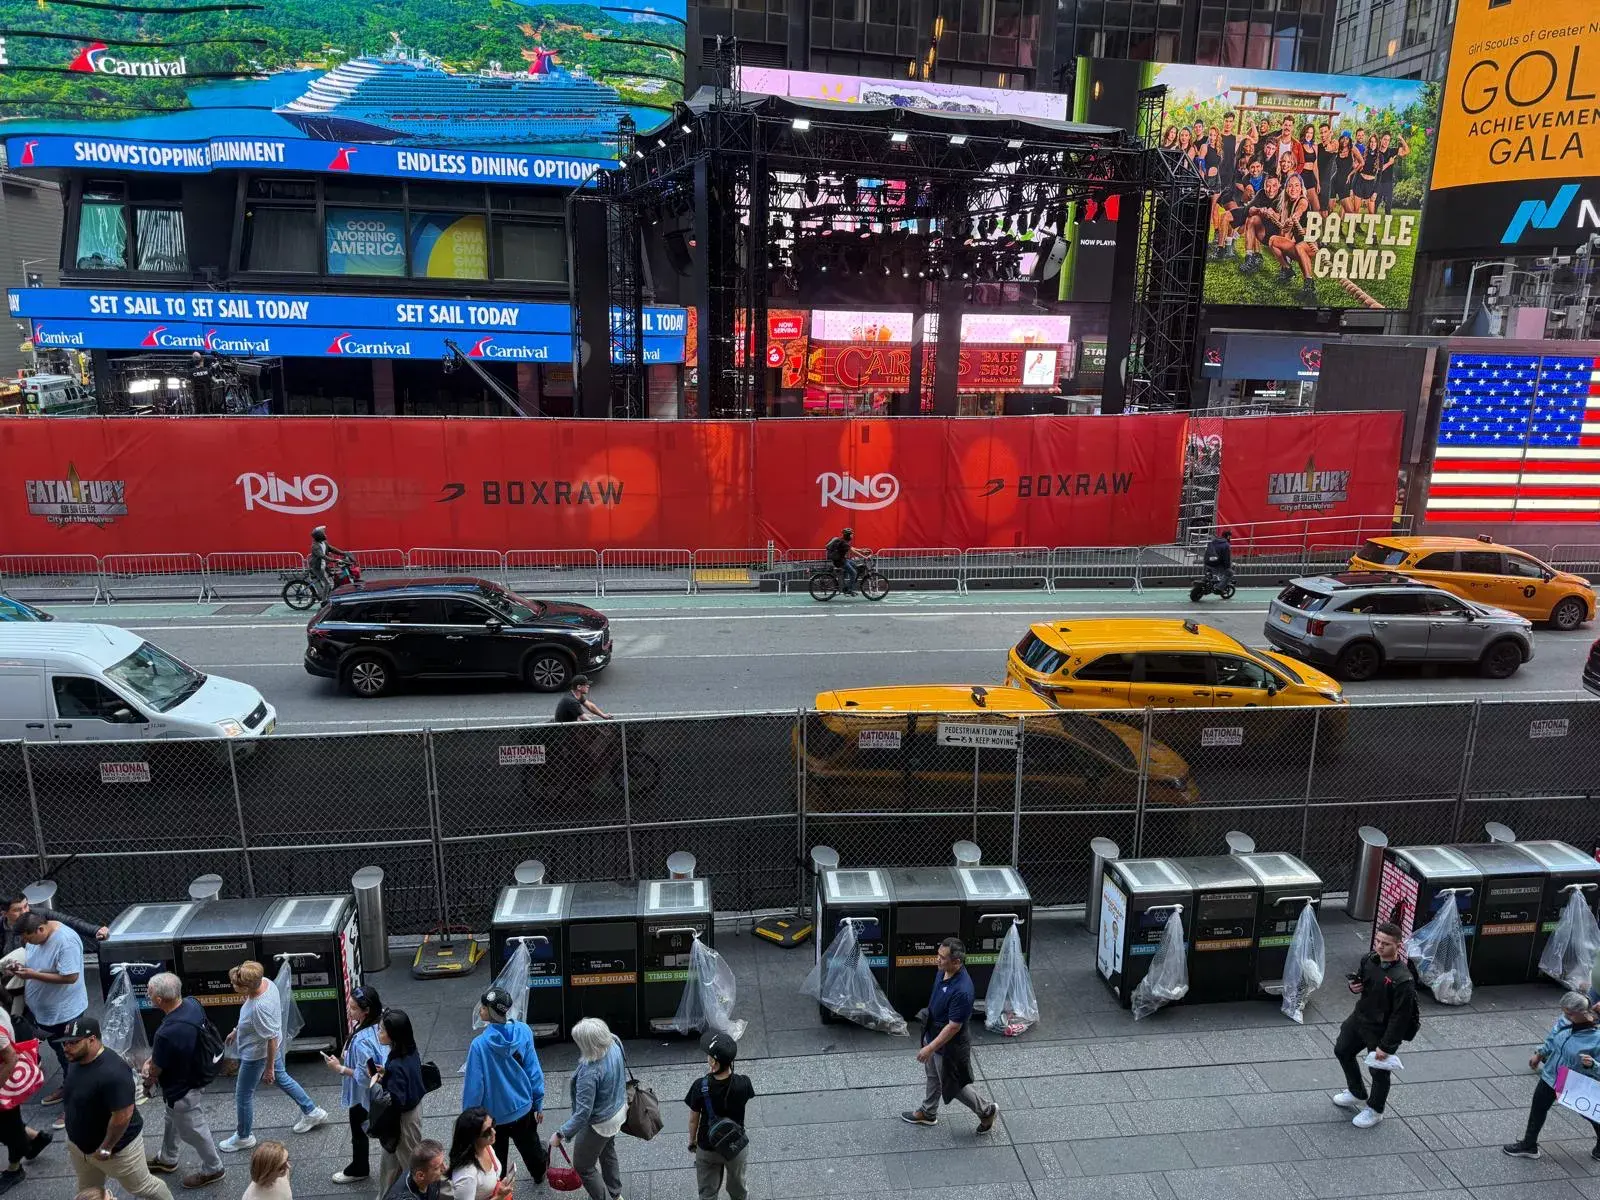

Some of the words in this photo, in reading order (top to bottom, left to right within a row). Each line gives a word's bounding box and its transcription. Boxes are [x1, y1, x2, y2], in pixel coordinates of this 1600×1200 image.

[1468, 43, 1483, 56] Girl
[1484, 36, 1519, 52] Scouts
[1523, 31, 1535, 42] of
[1538, 24, 1585, 40] Greater
[99, 56, 187, 77] Carnival
[1461, 45, 1596, 115] GOL
[1262, 96, 1292, 106] BATTLE
[1293, 98, 1316, 108] CAMP
[74, 141, 204, 167] SHOWSTOPPING
[1489, 132, 1584, 165] GALA
[398, 151, 466, 175] ENDLESS
[472, 153, 528, 177] DINING
[533, 158, 600, 181] OPTIONS
[346, 221, 386, 232] GOOD
[1303, 211, 1416, 246] BATTLE
[337, 230, 396, 243] MORNING
[453, 231, 484, 243] GMA
[329, 241, 405, 257] AMERICA
[453, 244, 485, 256] GMA
[453, 257, 485, 268] GMA
[1314, 249, 1397, 280] CAMP
[90, 295, 118, 315] SET
[124, 296, 161, 315] SAIL
[165, 298, 186, 315] TO
[191, 298, 214, 318] SET
[217, 299, 253, 319] SAIL
[256, 300, 309, 320] TODAY
[396, 304, 424, 323] SET
[429, 306, 464, 325] SAIL
[468, 306, 519, 326] TODAY
[656, 313, 684, 331] TODAY
[40, 331, 84, 345] Carnival
[212, 338, 270, 352] Carnival
[344, 341, 411, 355] Carnival
[486, 344, 548, 359] Carnival
[981, 352, 1019, 363] BAKE
[979, 364, 1018, 376] SHOP
[1017, 472, 1133, 498] BOXRAW
[1268, 472, 1310, 494] FATAL
[1311, 470, 1350, 492] FURY
[25, 480, 78, 503] FATAL
[80, 480, 125, 503] FURY
[235, 471, 339, 515] RING
[482, 480, 625, 505] BOXRAW
[816, 471, 900, 511] RING
[1279, 503, 1293, 511] City
[1301, 502, 1312, 510] the
[47, 515, 63, 524] City
[64, 515, 73, 523] of
[73, 515, 87, 523] the
[87, 515, 114, 523] Wolves
[860, 731, 900, 740] NATIONAL
[944, 726, 980, 735] PEDESTRIAN
[981, 728, 998, 736] FLOW
[998, 729, 1014, 737] ZONE
[1203, 728, 1242, 737] NATIONAL
[991, 738, 1014, 746] MOVING
[500, 746, 544, 756] NATIONAL
[101, 763, 147, 773] NATIONAL
[898, 957, 923, 965] TIMES
[574, 976, 600, 984] TIMES
[602, 974, 635, 983] SQUARE
[300, 990, 336, 998] SQUARE
